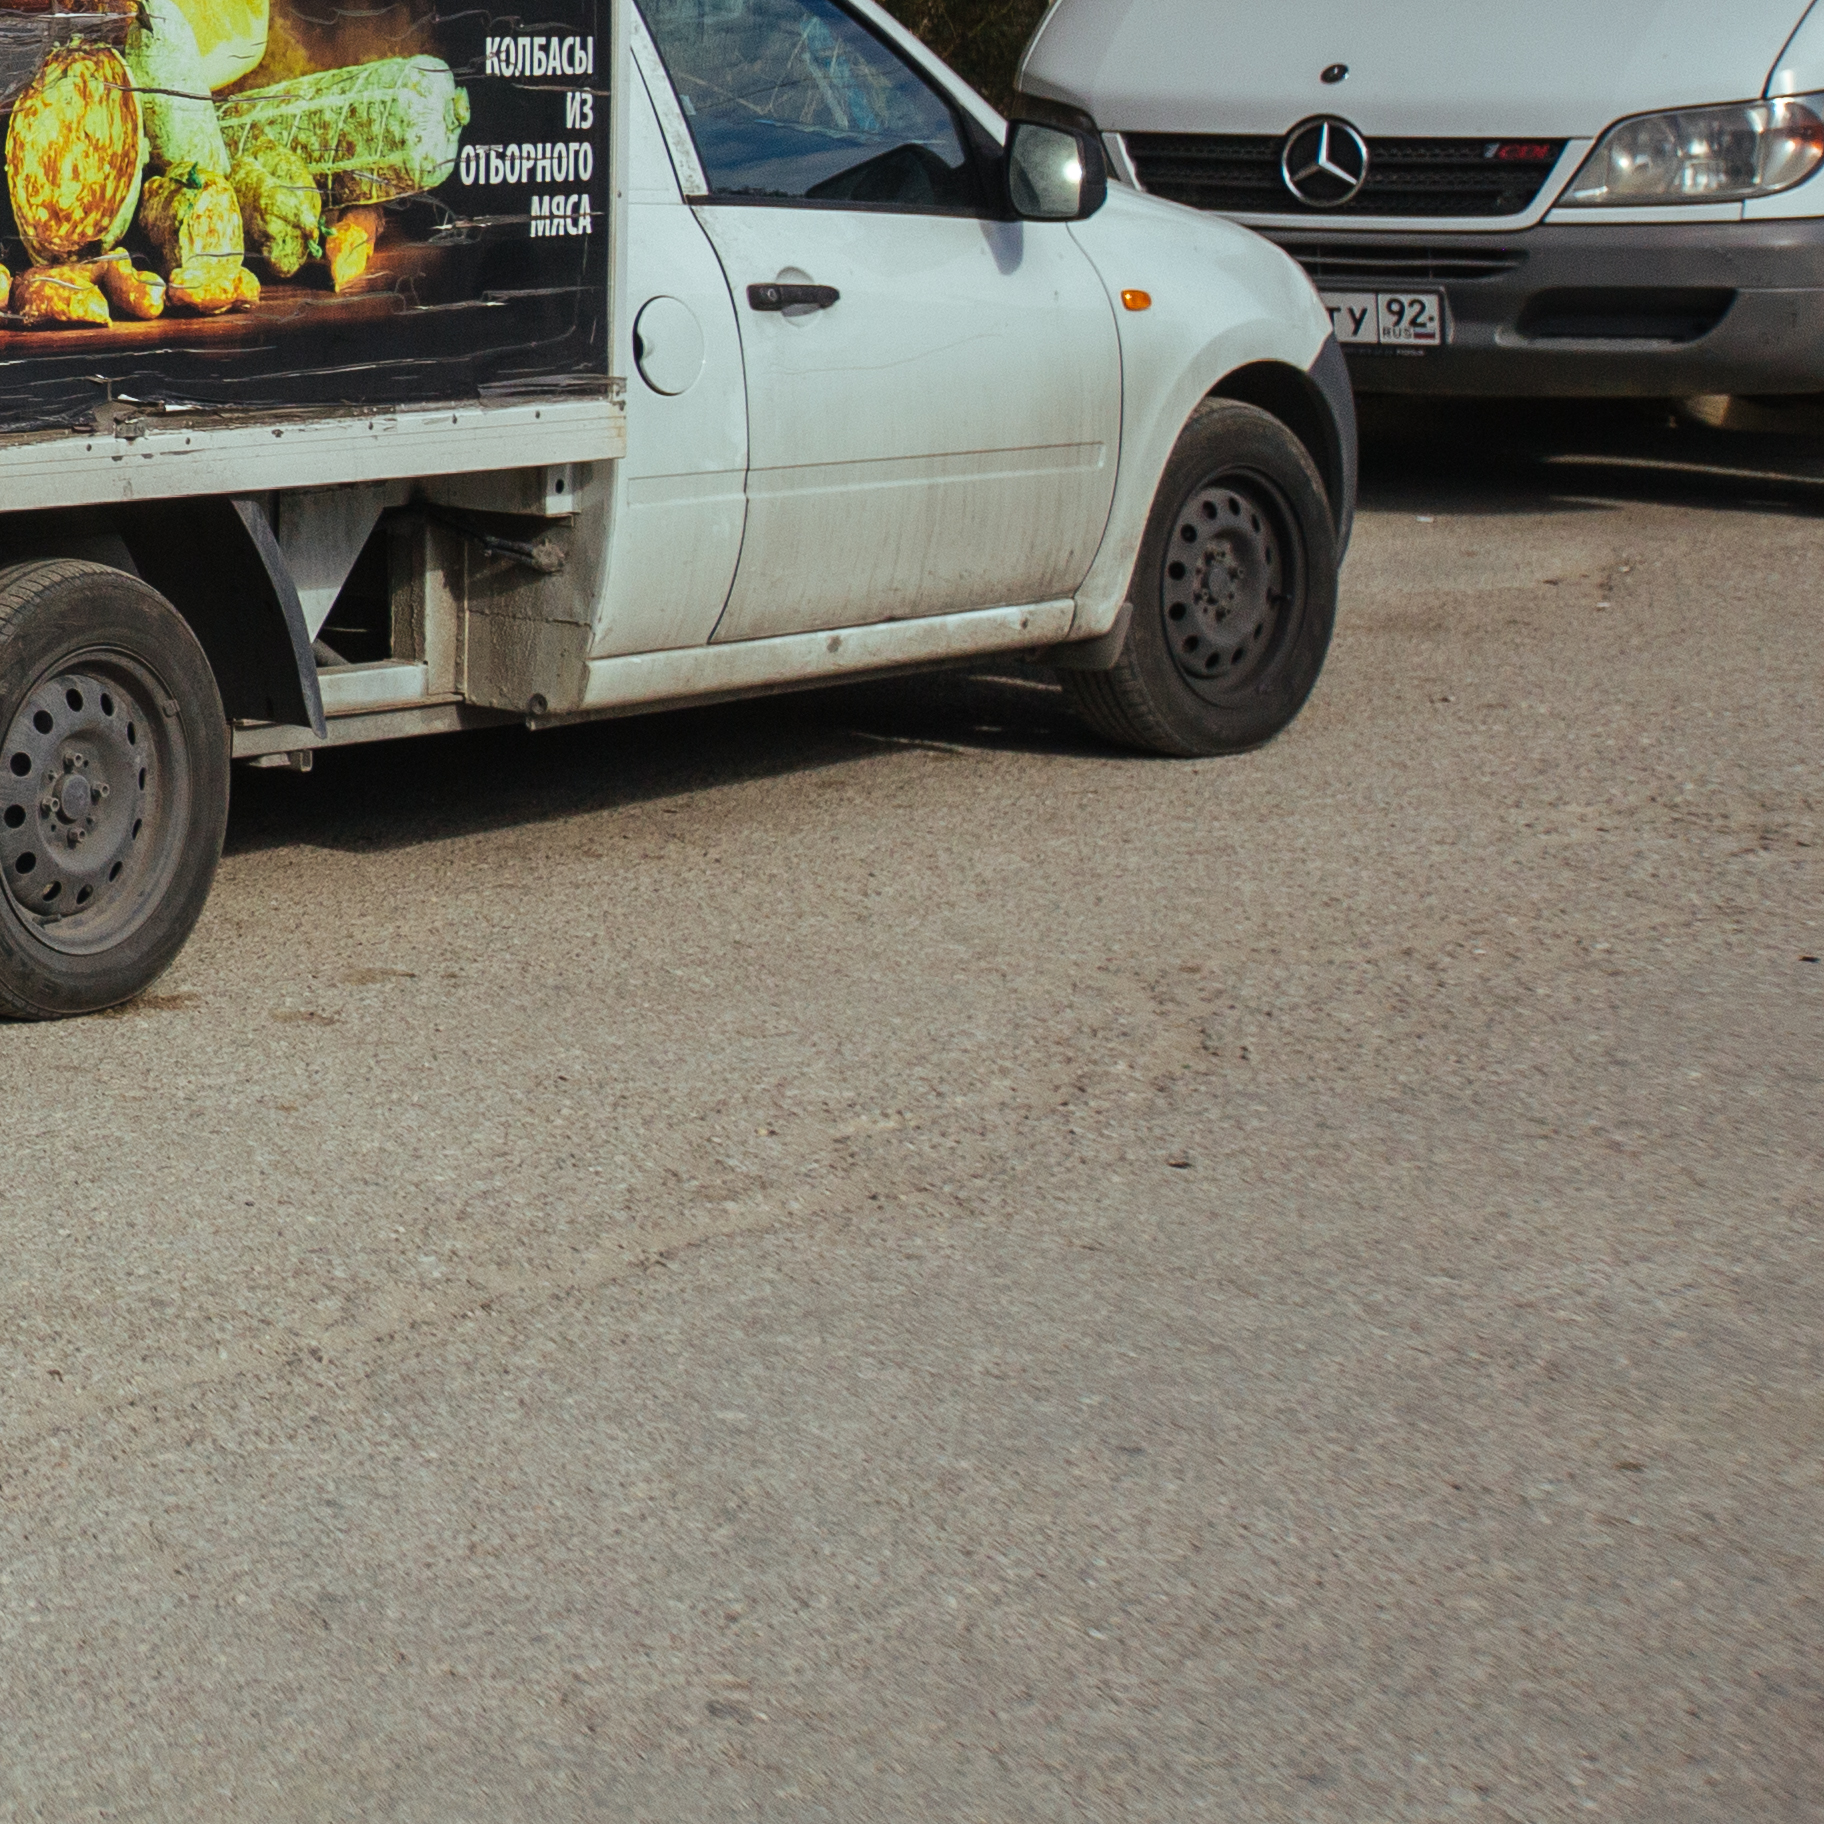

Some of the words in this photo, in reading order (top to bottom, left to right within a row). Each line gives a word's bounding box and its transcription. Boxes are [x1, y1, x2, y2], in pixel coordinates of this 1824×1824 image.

[485, 36, 594, 77] КОЛБАСЫ
[566, 90, 594, 130] ИЗ
[459, 141, 594, 186] ОТБОРНОГО
[530, 194, 593, 238] МЯСА
[1386, 297, 1428, 328] 92
[1382, 326, 1413, 341] RUS
